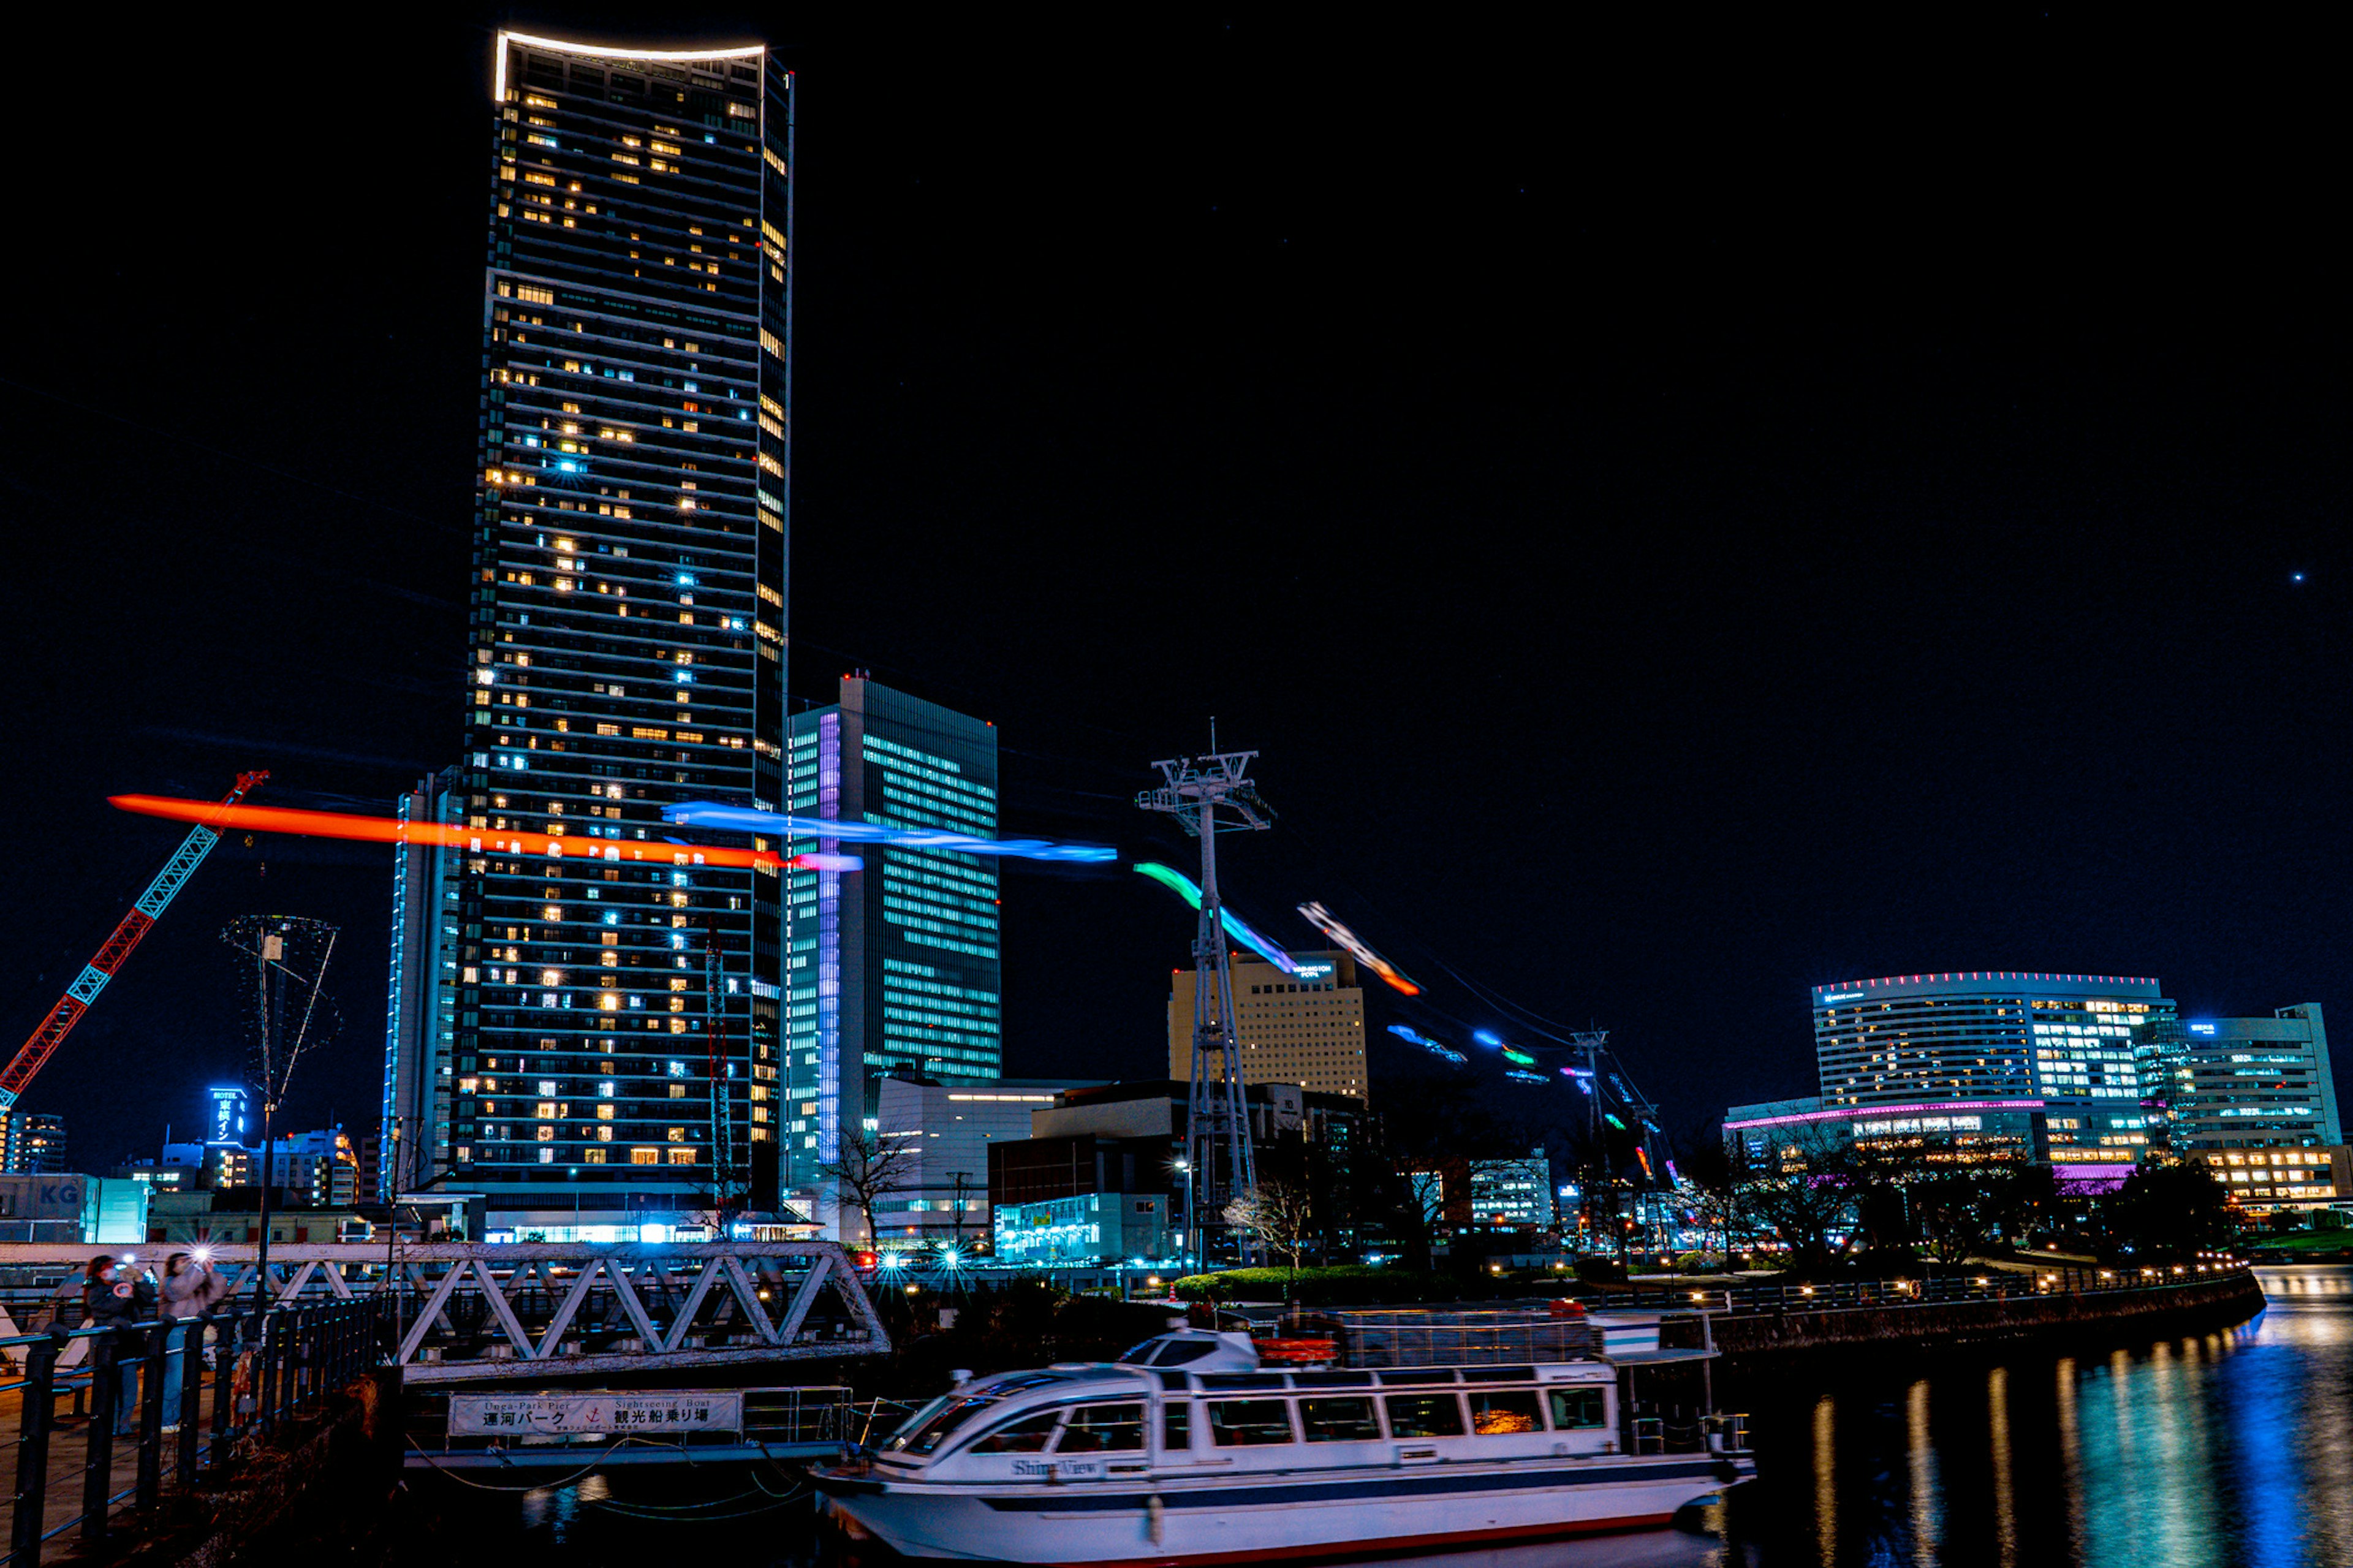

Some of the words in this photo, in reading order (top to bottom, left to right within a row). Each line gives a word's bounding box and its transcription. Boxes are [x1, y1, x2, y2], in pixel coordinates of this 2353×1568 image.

[218, 1100, 231, 1141] 東横イン
[40, 1186, 78, 1204] KG
[485, 1403, 542, 1412] Unga-Park
[547, 1401, 570, 1411] Pier
[615, 1401, 678, 1411] Sightseeing
[686, 1399, 710, 1408] Boat
[483, 1411, 565, 1426] 運河パーク
[615, 1409, 709, 1425] 観光船乗り場
